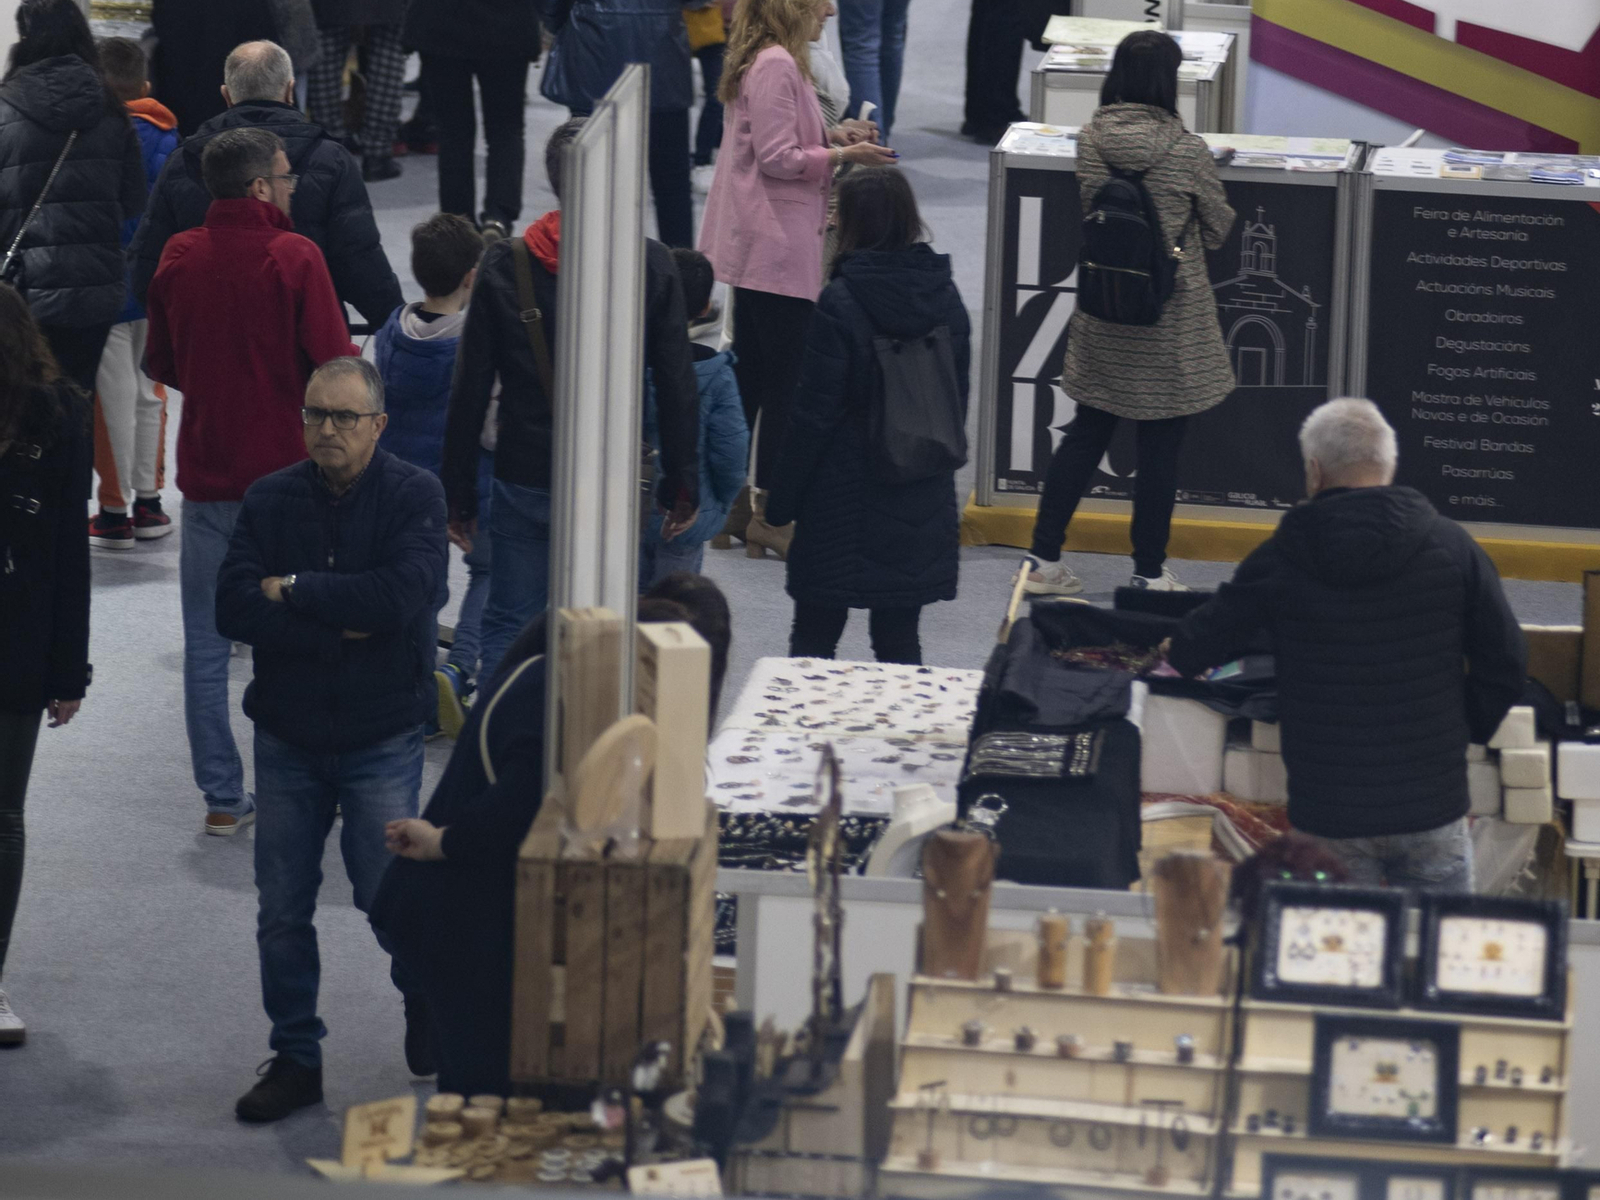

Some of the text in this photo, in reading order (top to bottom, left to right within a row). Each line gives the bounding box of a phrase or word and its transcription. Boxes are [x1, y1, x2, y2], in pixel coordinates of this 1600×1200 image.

[1413, 206, 1564, 226] Feira de Alimentación
[1447, 227, 1529, 241] e Artesanía
[1406, 251, 1567, 272] Actividades Deportivas
[1415, 280, 1556, 299] Actuacións Musicais
[1445, 309, 1524, 325] Obradoiros
[1436, 336, 1531, 354] Degustacións
[1427, 363, 1537, 381] Fogos Artificiais
[1412, 391, 1550, 410] Mostra de Vehículos
[1412, 408, 1549, 426] Novos e de Ocasión
[1423, 436, 1535, 453] Festival Bandas
[1442, 465, 1514, 480] Pasarrúas
[1449, 495, 1458, 505] e
